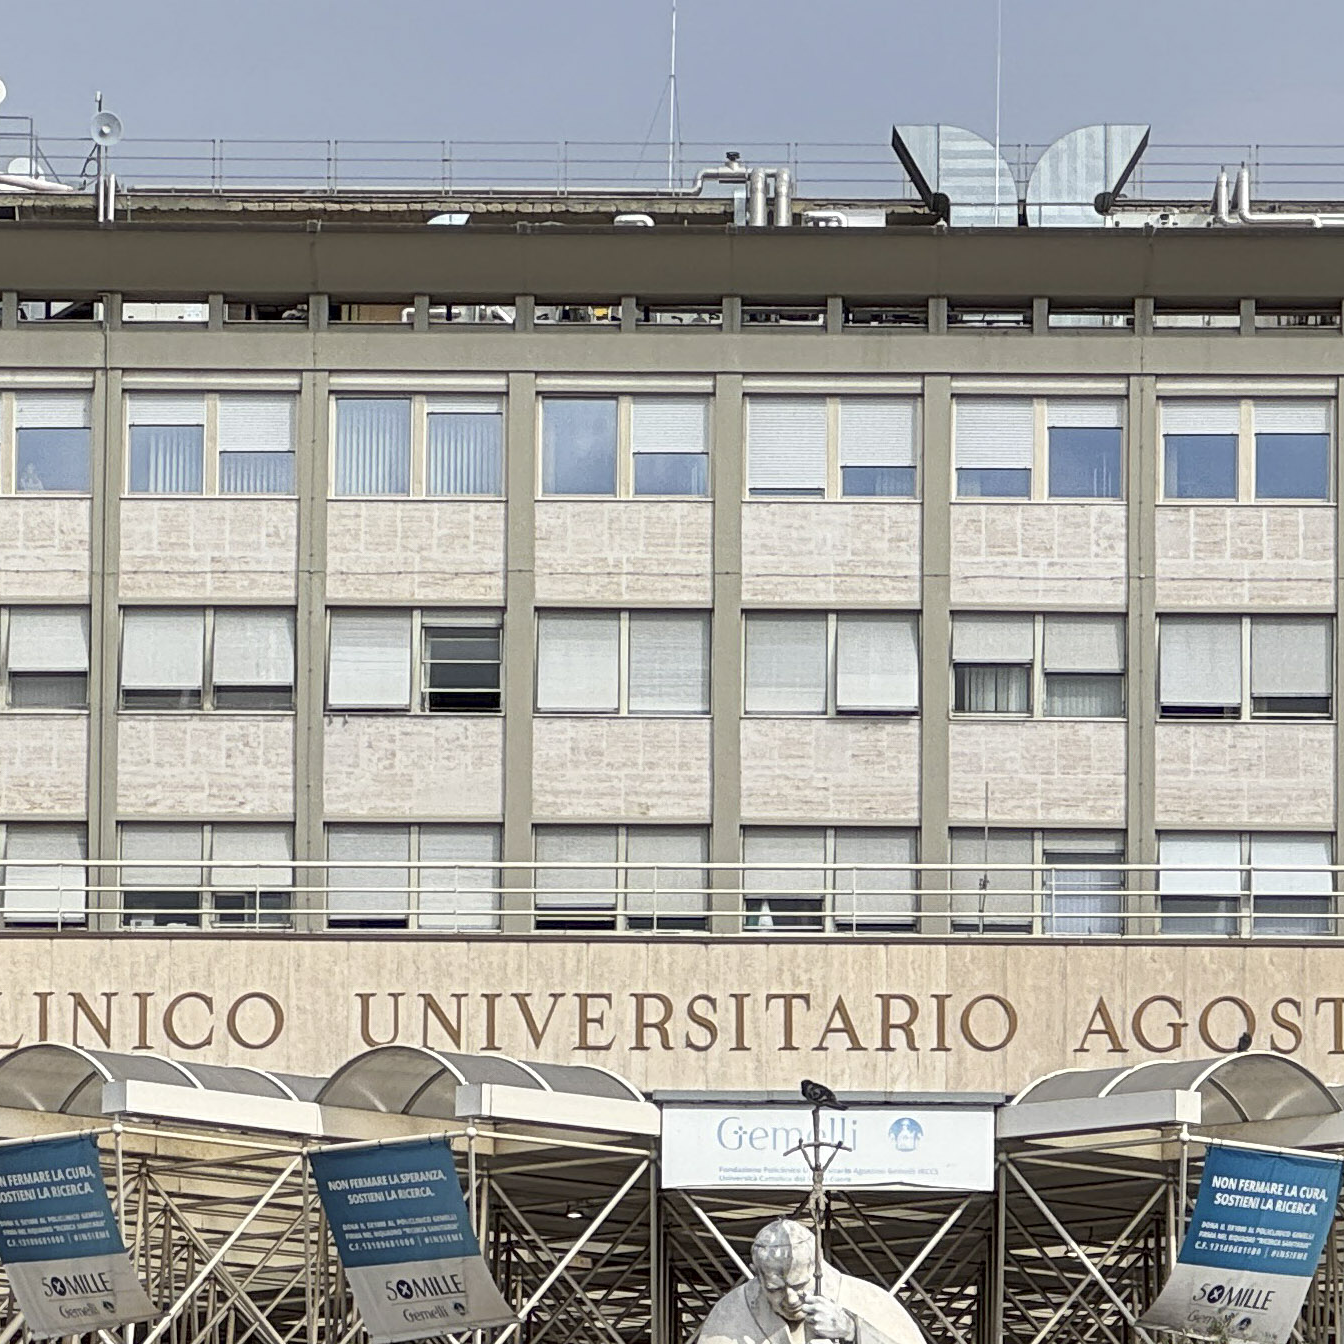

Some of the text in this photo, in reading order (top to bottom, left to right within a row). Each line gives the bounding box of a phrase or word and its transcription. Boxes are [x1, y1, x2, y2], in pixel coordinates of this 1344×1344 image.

[355, 993, 1019, 1053] UNIVERSITARIO
[9, 1171, 51, 1187] FERMARE
[52, 1170, 65, 1181] LA
[66, 1165, 95, 1179] CURA,
[327, 1169, 447, 1192] NON FERMARE LA SPERANZA,
[37, 1188, 50, 1198] LA
[347, 1192, 385, 1205] SOSTIENI
[386, 1191, 397, 1200] LA
[1212, 1176, 1328, 1202] NON FERMARE LA CURA,
[1214, 1193, 1318, 1216] SOSTIENI LA RICERCA.
[403, 1305, 449, 1323] Gemelli
